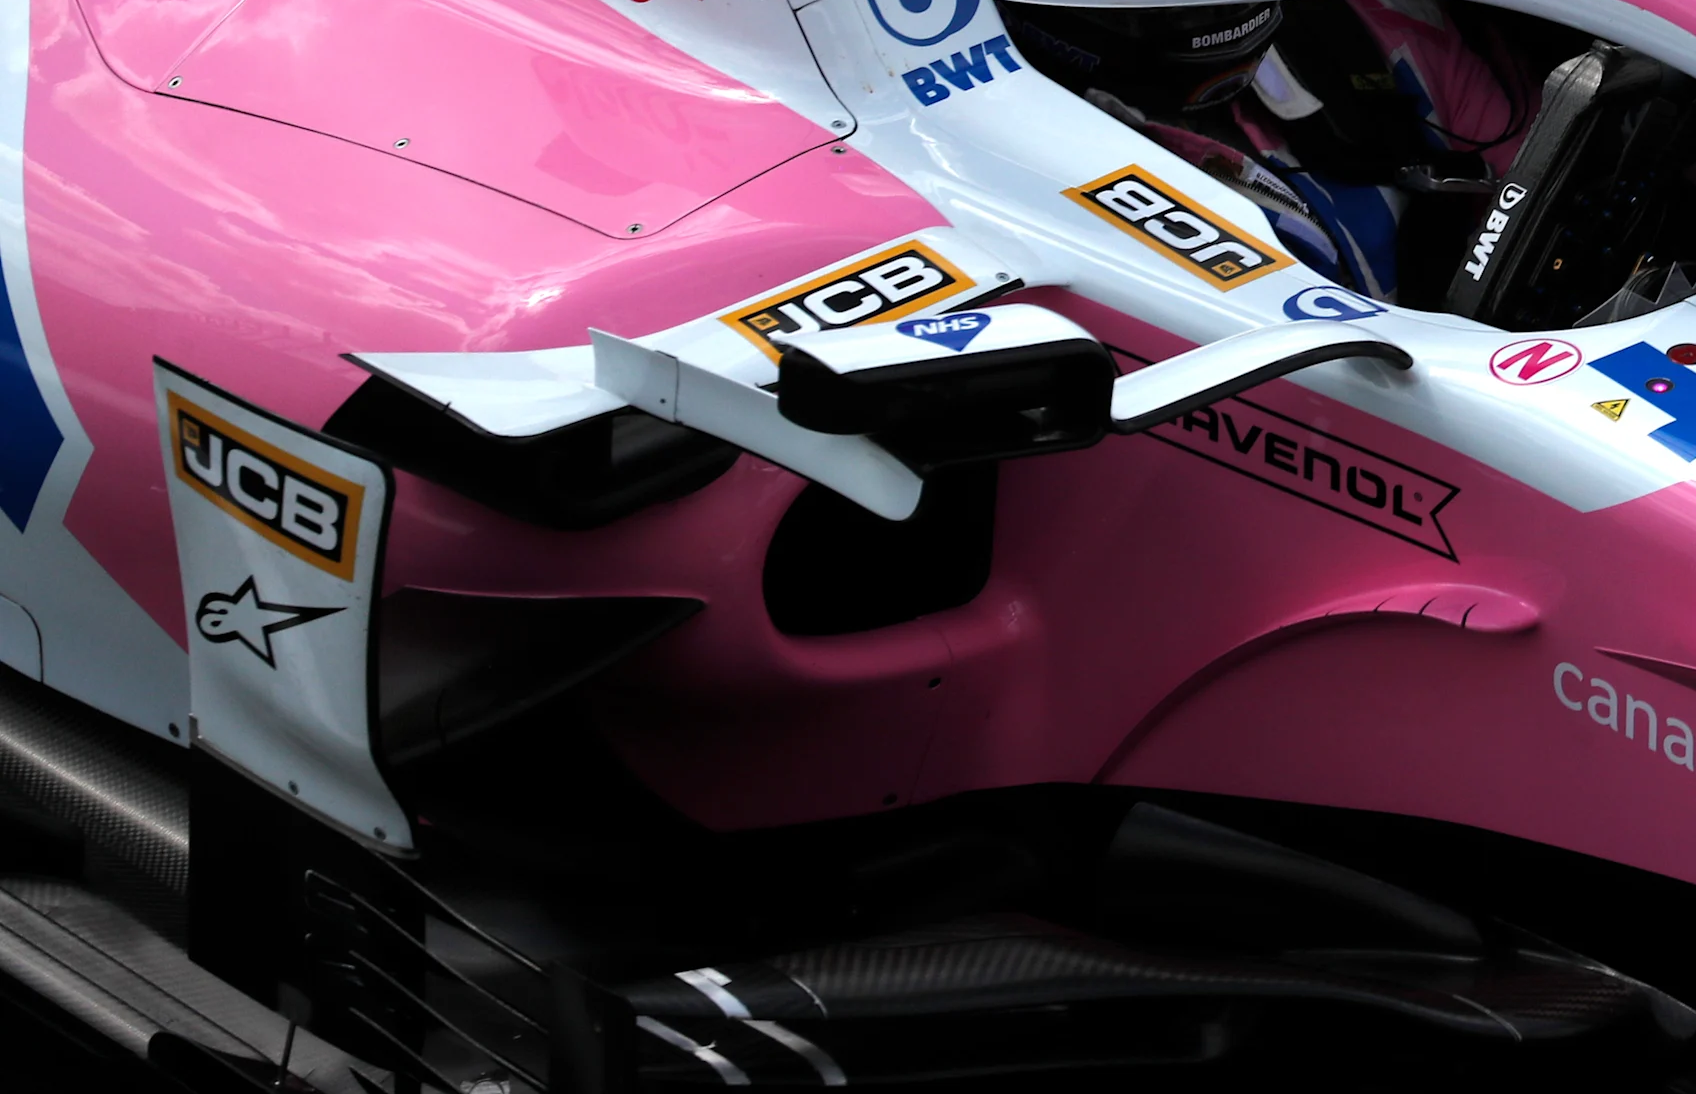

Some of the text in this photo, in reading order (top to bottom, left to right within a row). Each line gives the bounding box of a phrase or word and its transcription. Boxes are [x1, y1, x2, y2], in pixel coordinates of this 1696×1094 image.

[1192, 8, 1271, 49] BOMBARDIER
[902, 34, 1023, 106] BWT
[1095, 180, 1262, 268] JCB
[1464, 209, 1510, 281] BWT
[768, 256, 944, 340] JCB
[912, 316, 980, 337] NHS
[184, 433, 340, 552] JCB
[1172, 405, 1423, 527] AVENOL
